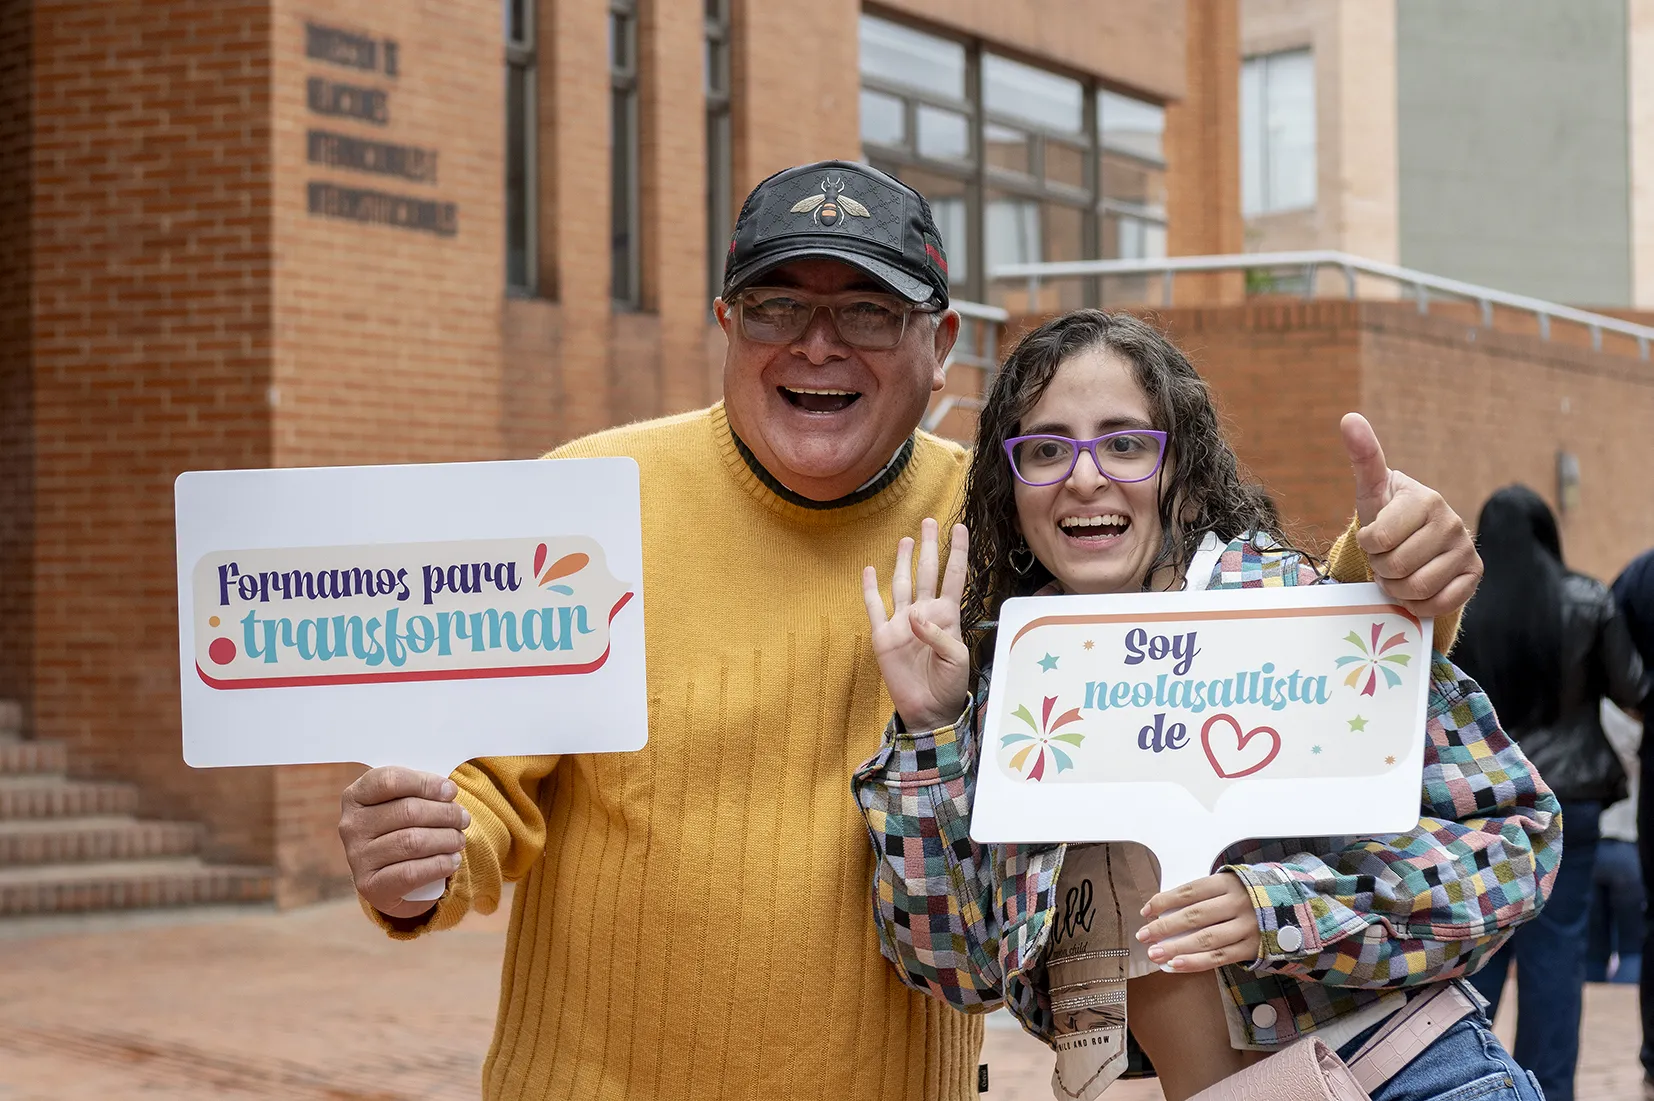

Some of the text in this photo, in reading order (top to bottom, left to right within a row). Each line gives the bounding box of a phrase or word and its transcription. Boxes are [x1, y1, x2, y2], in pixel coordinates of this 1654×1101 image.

[218, 560, 522, 606] Formamos para
[240, 603, 596, 667] transformar
[1123, 627, 1201, 676] Soy
[1082, 662, 1333, 714] neolasallista
[1137, 713, 1190, 753] de
[1073, 1039, 1088, 1049] AND
